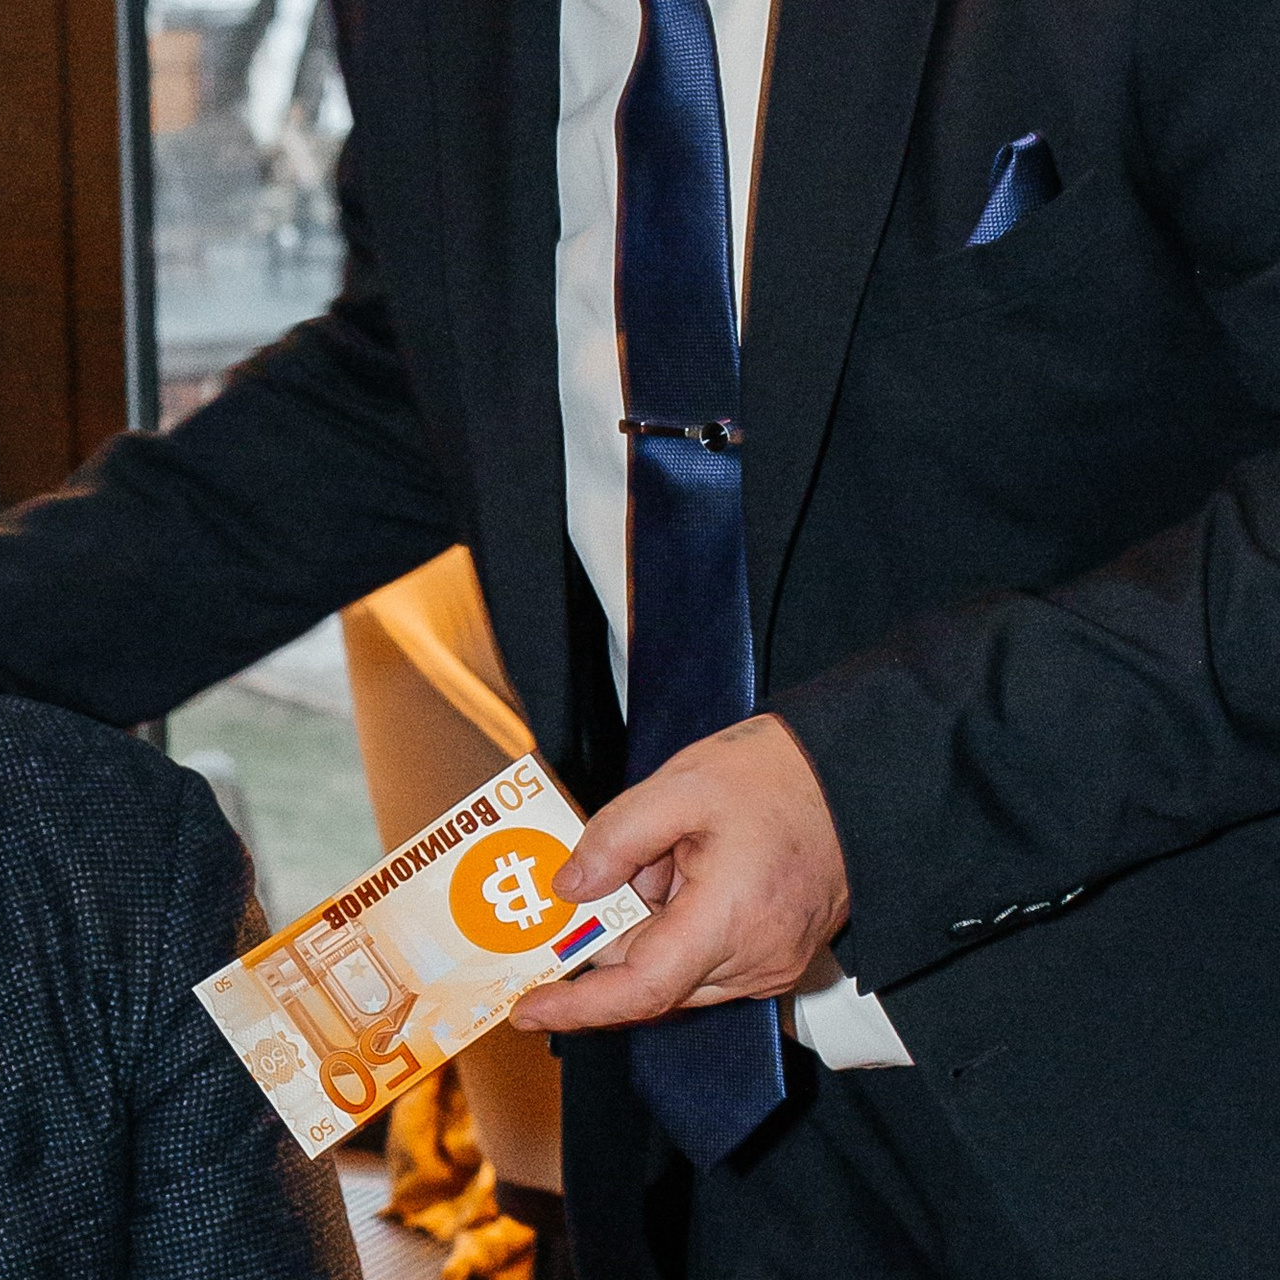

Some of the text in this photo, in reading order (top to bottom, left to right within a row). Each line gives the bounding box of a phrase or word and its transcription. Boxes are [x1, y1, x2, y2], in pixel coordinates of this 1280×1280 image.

[322, 763, 544, 931] 50 Велихоинов
[602, 895, 639, 930] 50
[213, 975, 233, 994] 50
[260, 1047, 287, 1074] 50
[318, 1016, 422, 1114] 50
[309, 1117, 335, 1142] 50
